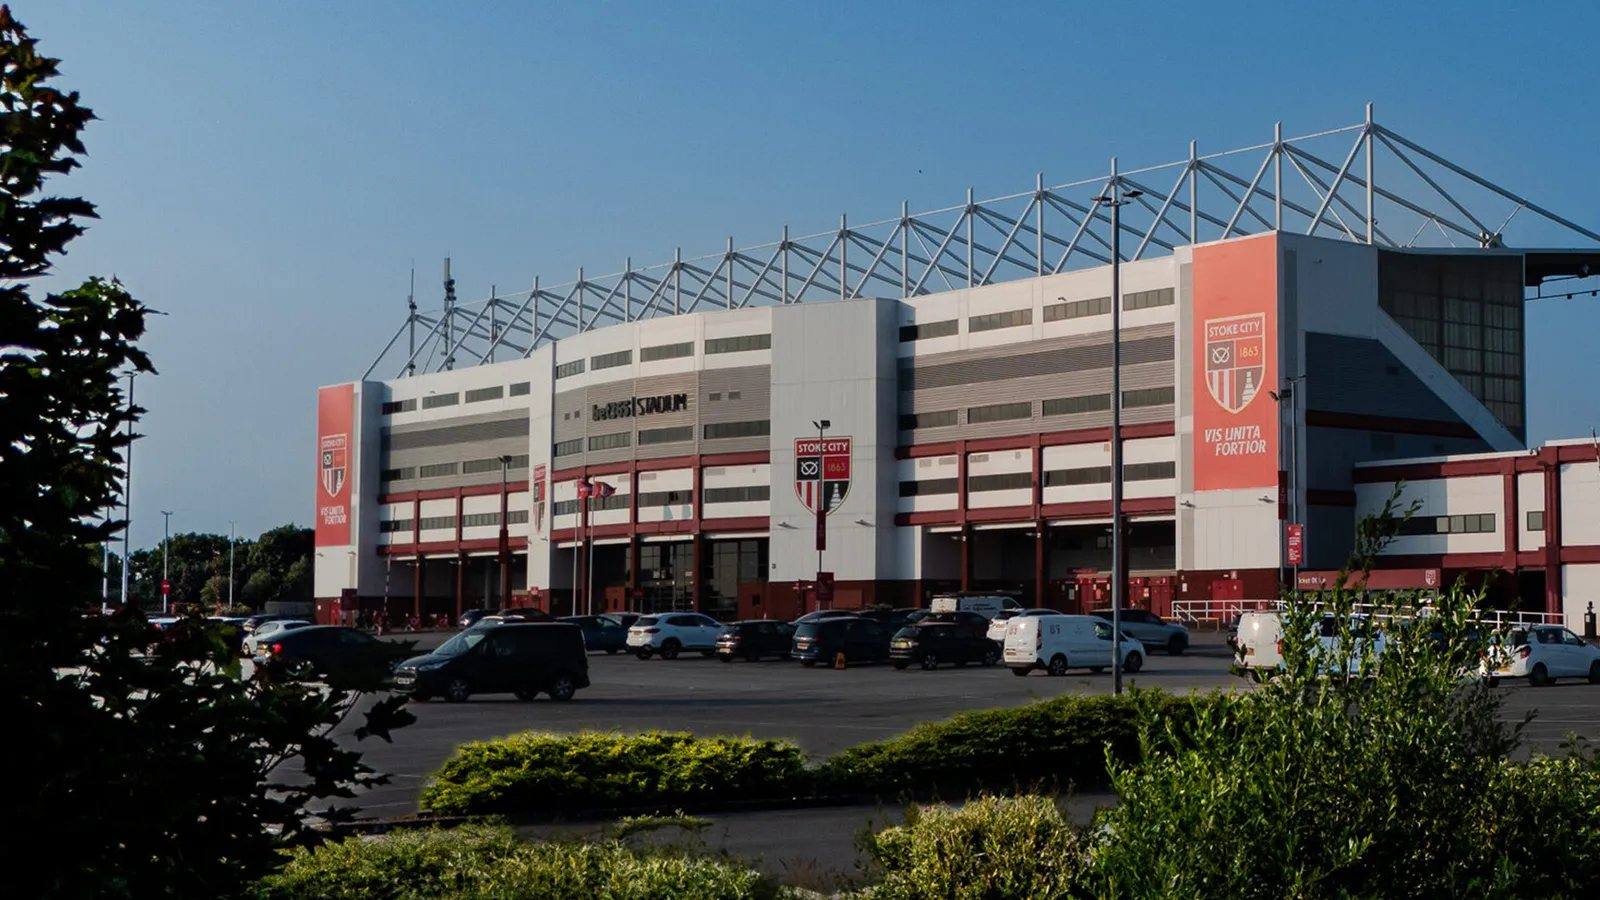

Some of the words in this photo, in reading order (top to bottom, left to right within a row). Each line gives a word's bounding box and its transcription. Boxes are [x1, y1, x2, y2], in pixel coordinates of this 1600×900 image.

[1209, 323, 1238, 337] STOKE
[1240, 320, 1260, 333] CITY
[1240, 345, 1259, 358] 1863
[637, 394, 687, 415] STADIUM
[1204, 428, 1223, 443] VIS
[1225, 425, 1261, 441] UNITA
[798, 443, 827, 452] STOKE
[828, 442, 848, 452] CITY
[1215, 439, 1267, 457] FORTIOR
[828, 462, 846, 472] 1863
